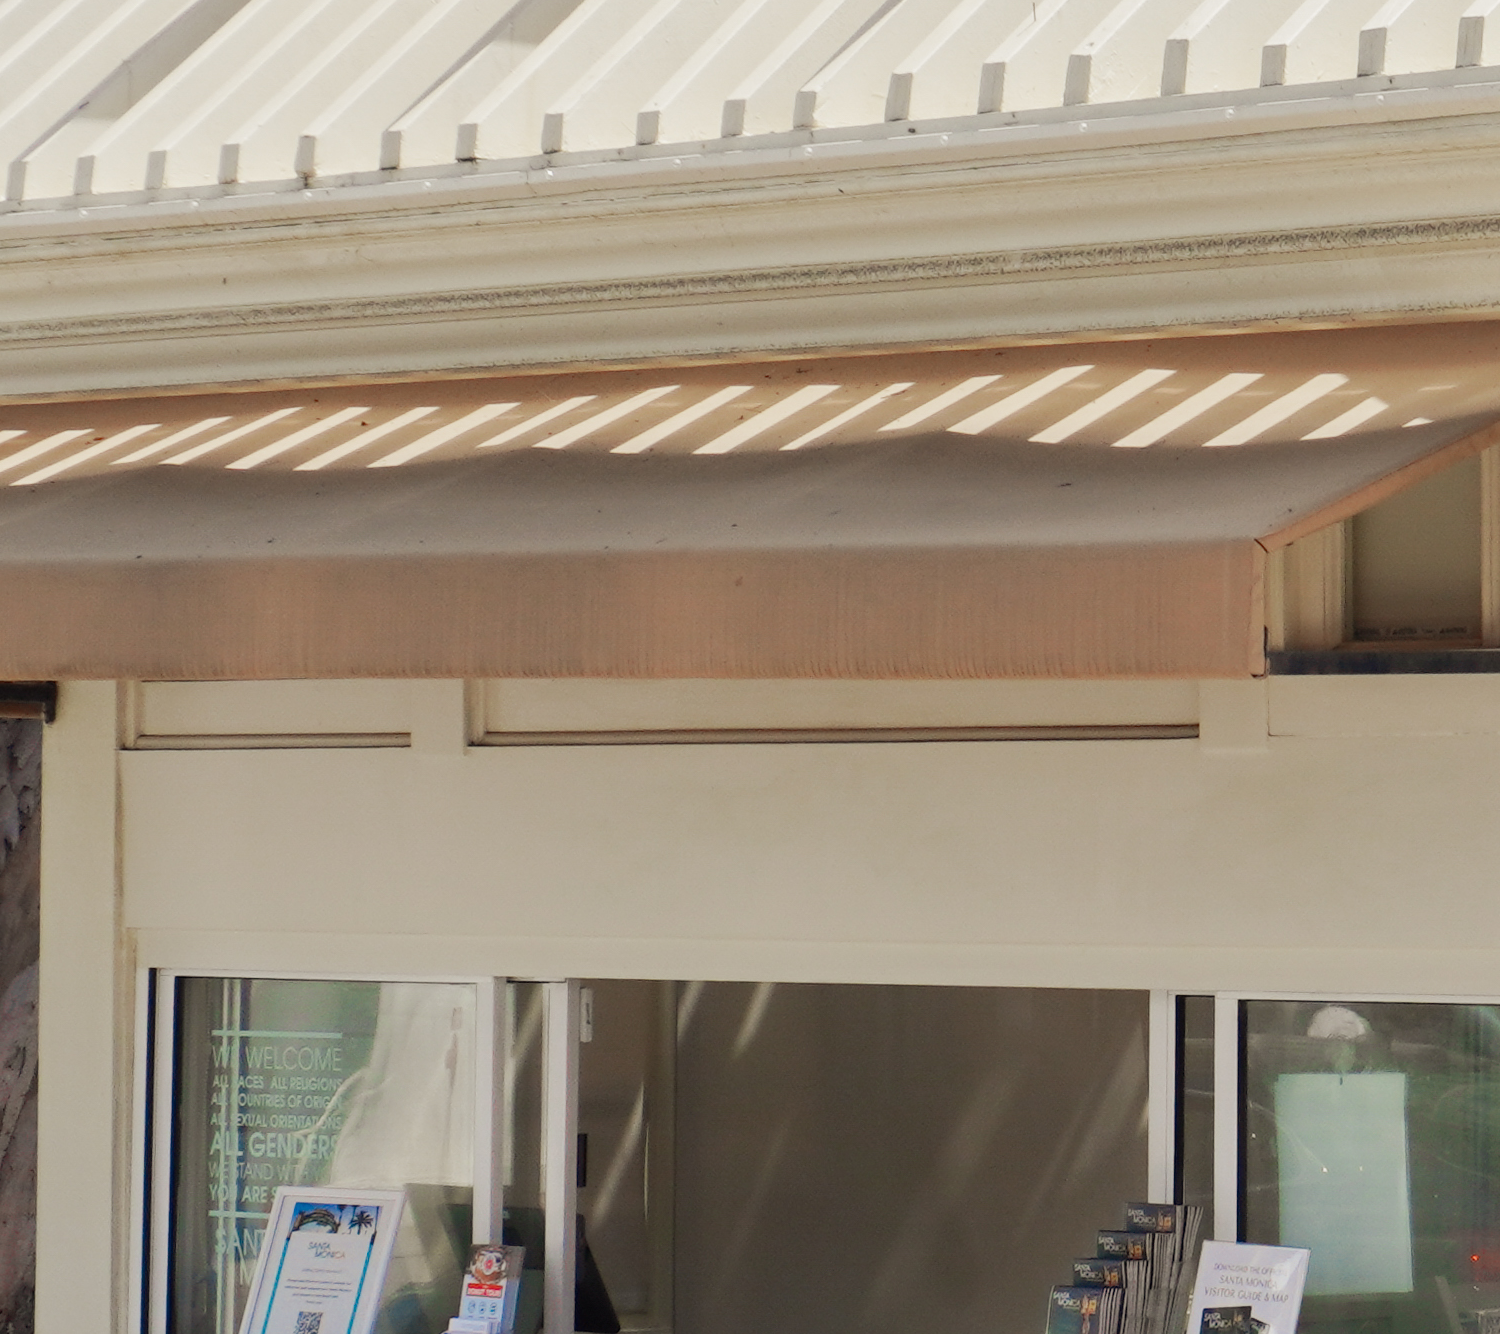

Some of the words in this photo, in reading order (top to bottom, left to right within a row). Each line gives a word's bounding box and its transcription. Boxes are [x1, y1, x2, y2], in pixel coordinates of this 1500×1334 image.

[245, 1046, 342, 1071] WELCOME
[236, 1076, 264, 1089] ACES
[270, 1077, 288, 1090] ALL
[290, 1078, 342, 1092] RELIGIONS
[237, 1093, 285, 1108] OUNTRIES
[287, 1095, 303, 1108] OF
[236, 1113, 267, 1127] EXUAL
[241, 1186, 272, 1203] ARE
[1219, 1275, 1243, 1286] SANTA
[1204, 1287, 1236, 1299] VISITOR
[1238, 1290, 1262, 1302] GUIDE
